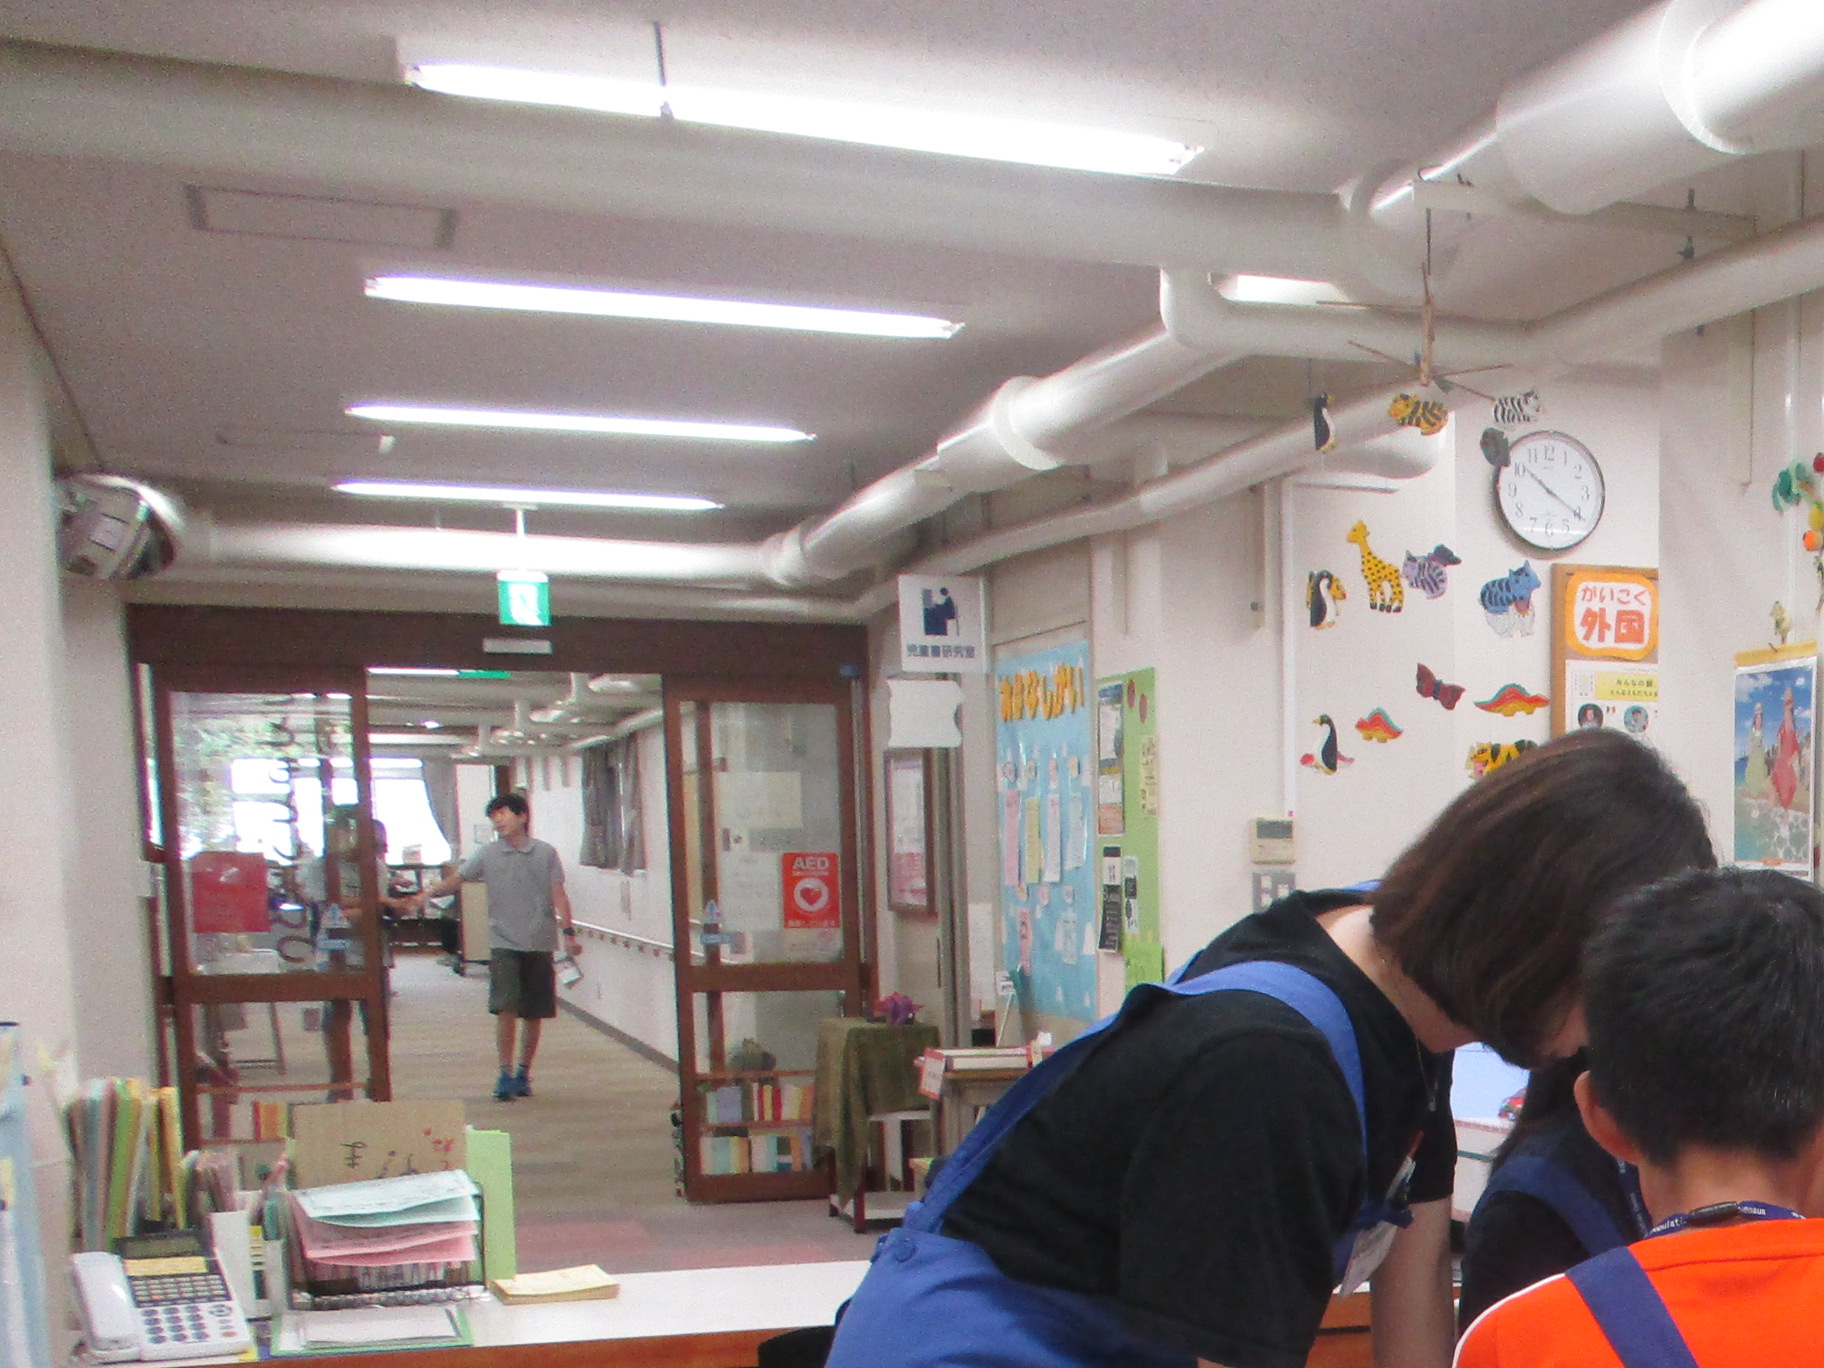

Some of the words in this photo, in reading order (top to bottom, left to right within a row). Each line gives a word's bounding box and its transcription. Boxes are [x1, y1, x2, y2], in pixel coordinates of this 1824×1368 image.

[1528, 448, 1538, 463] 11
[1544, 445, 1555, 461] 12
[1563, 450, 1568, 466] 1
[1514, 462, 1526, 477] 10
[1574, 464, 1582, 479] 2
[1508, 483, 1517, 498] 9
[1581, 485, 1590, 500] 3
[1515, 502, 1524, 518] 8
[1573, 506, 1582, 520] 4
[1529, 517, 1538, 532] 7
[1544, 520, 1554, 537] 6
[1562, 518, 1570, 533] 5
[1581, 586, 1647, 606] がいこく
[1580, 607, 1645, 643] 外国
[793, 857, 829, 870] AED
